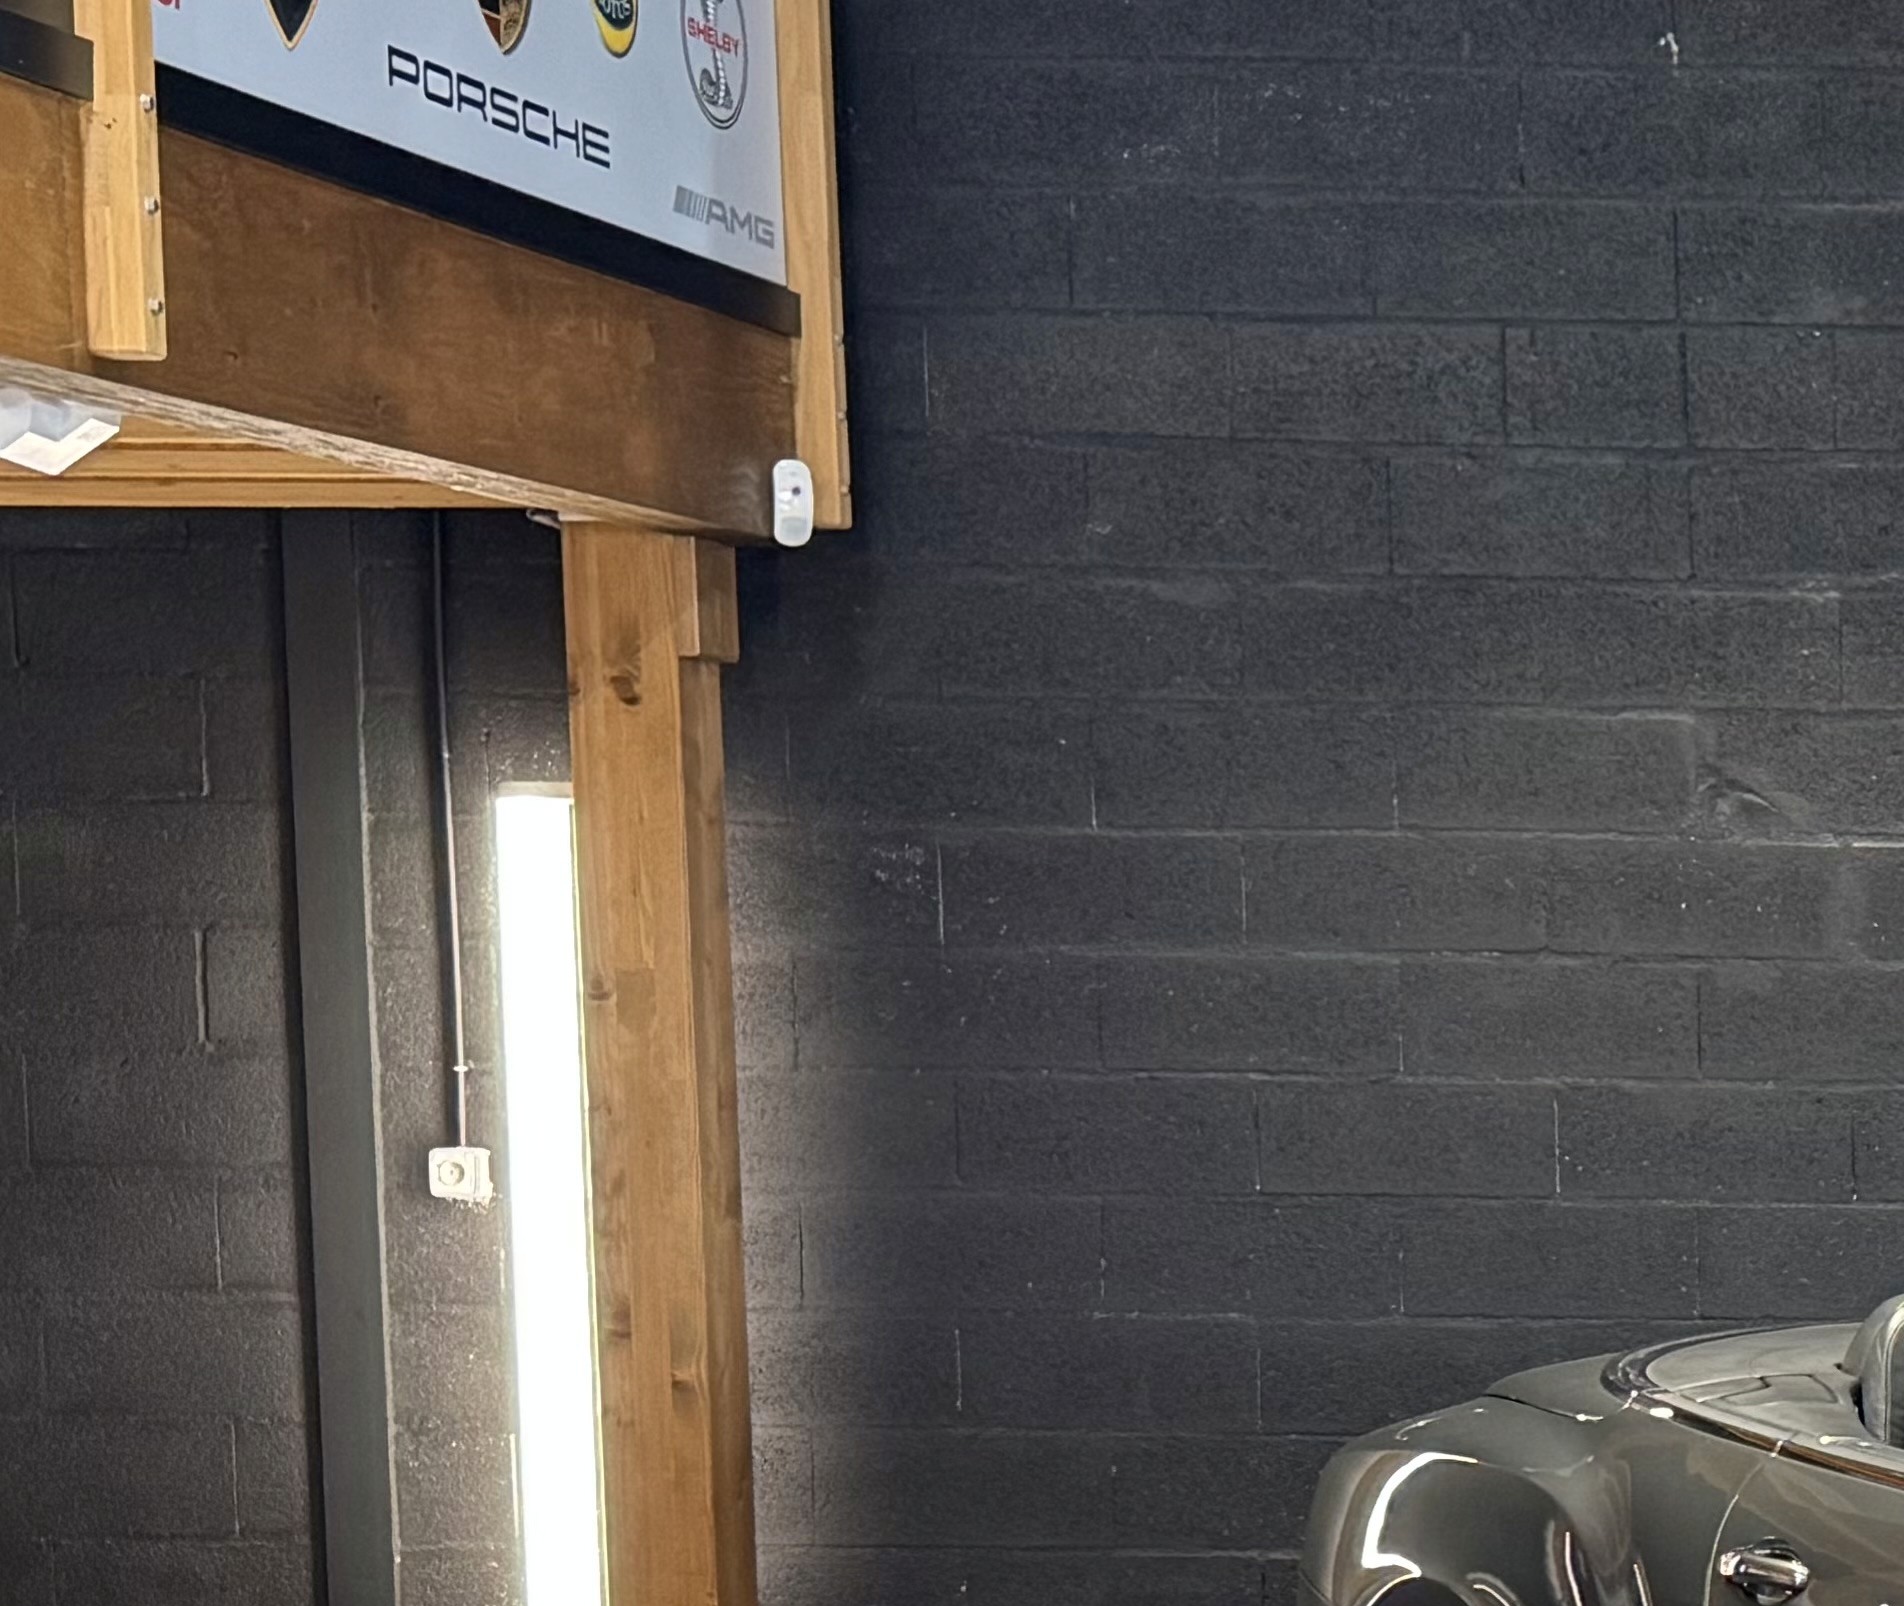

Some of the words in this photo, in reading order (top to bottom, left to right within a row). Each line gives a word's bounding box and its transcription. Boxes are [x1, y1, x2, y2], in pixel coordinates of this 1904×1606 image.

[687, 16, 740, 58] SHELBY
[388, 45, 612, 169] PORSCHE
[704, 200, 776, 249] AMG
